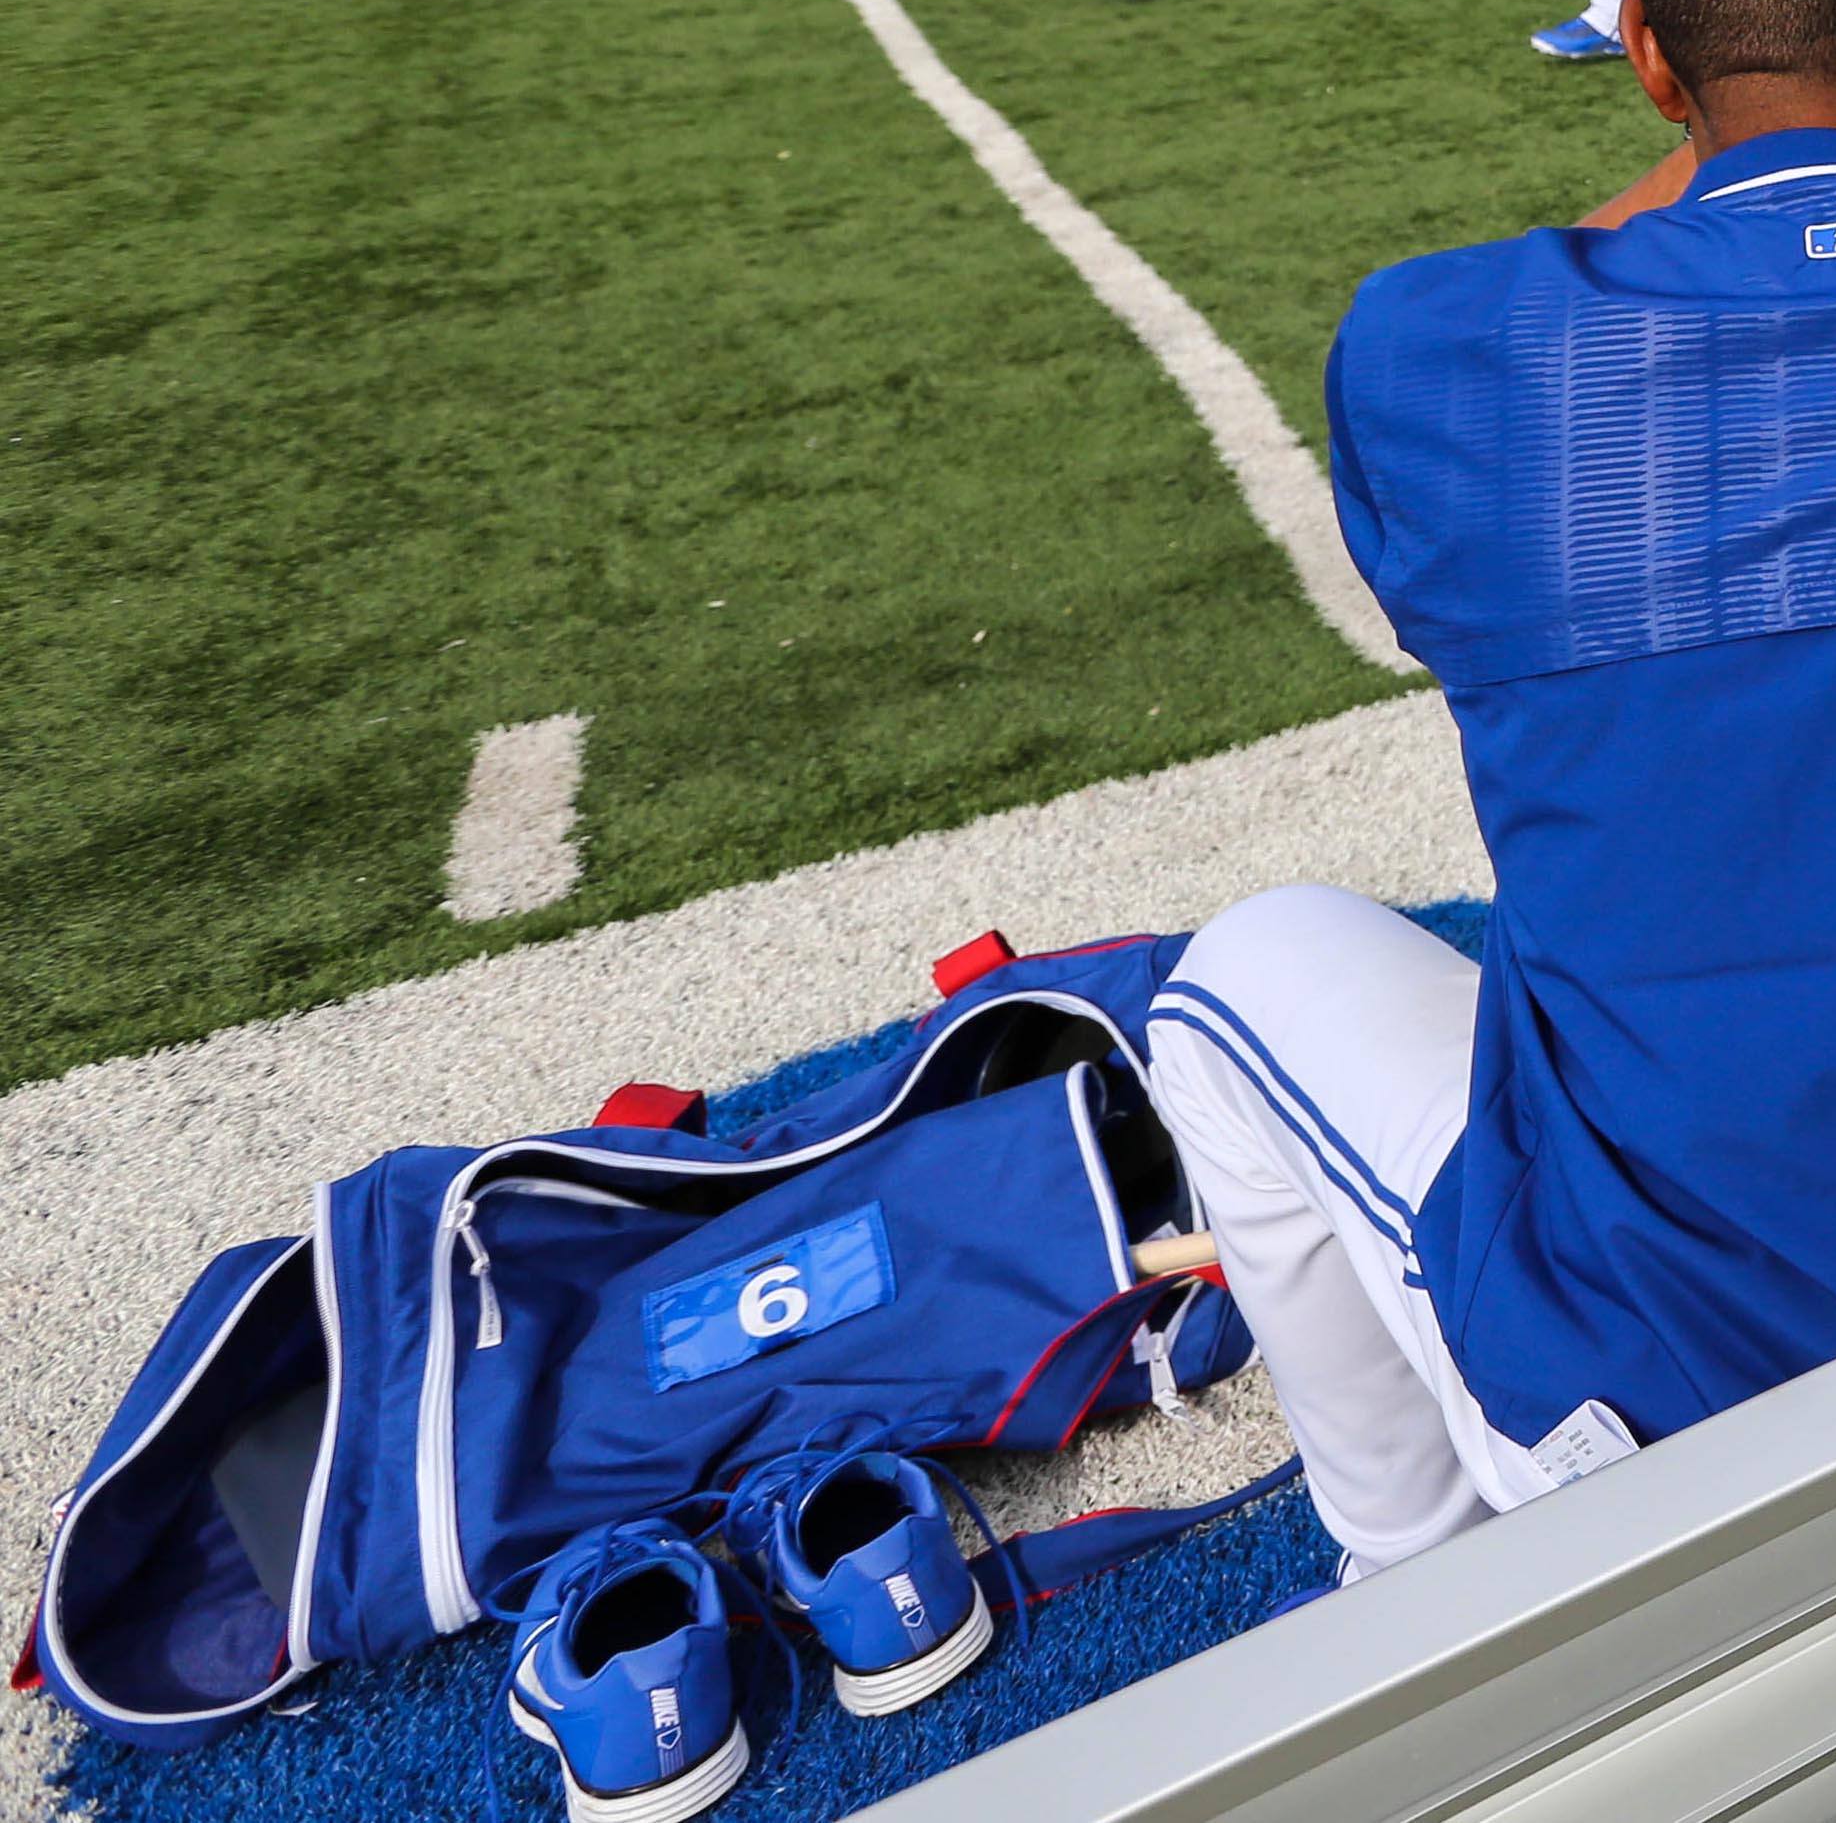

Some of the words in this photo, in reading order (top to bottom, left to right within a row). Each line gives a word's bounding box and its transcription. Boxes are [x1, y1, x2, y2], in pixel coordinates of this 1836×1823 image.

[737, 1263, 809, 1340] 6
[884, 1570, 922, 1613] NIKE
[649, 1686, 681, 1729] NIKE
